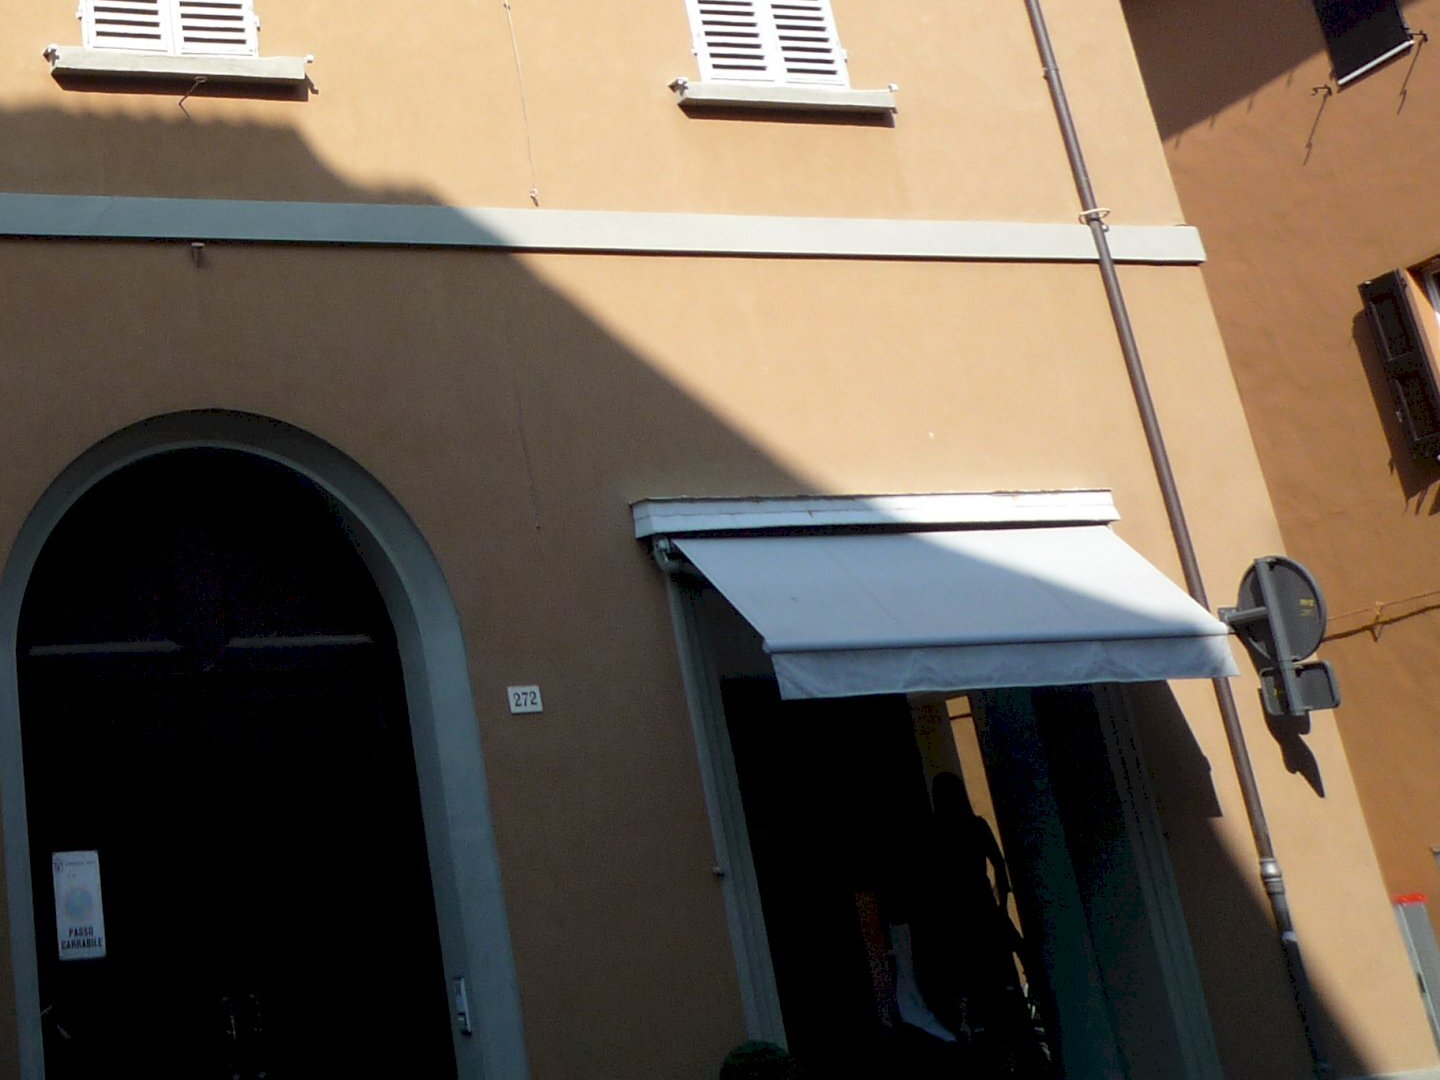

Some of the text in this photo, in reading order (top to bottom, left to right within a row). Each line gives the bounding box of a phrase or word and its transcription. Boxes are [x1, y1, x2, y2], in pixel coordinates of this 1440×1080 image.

[513, 691, 537, 707] 272
[68, 926, 94, 937] PASSO
[61, 937, 102, 950] CARRABILE
